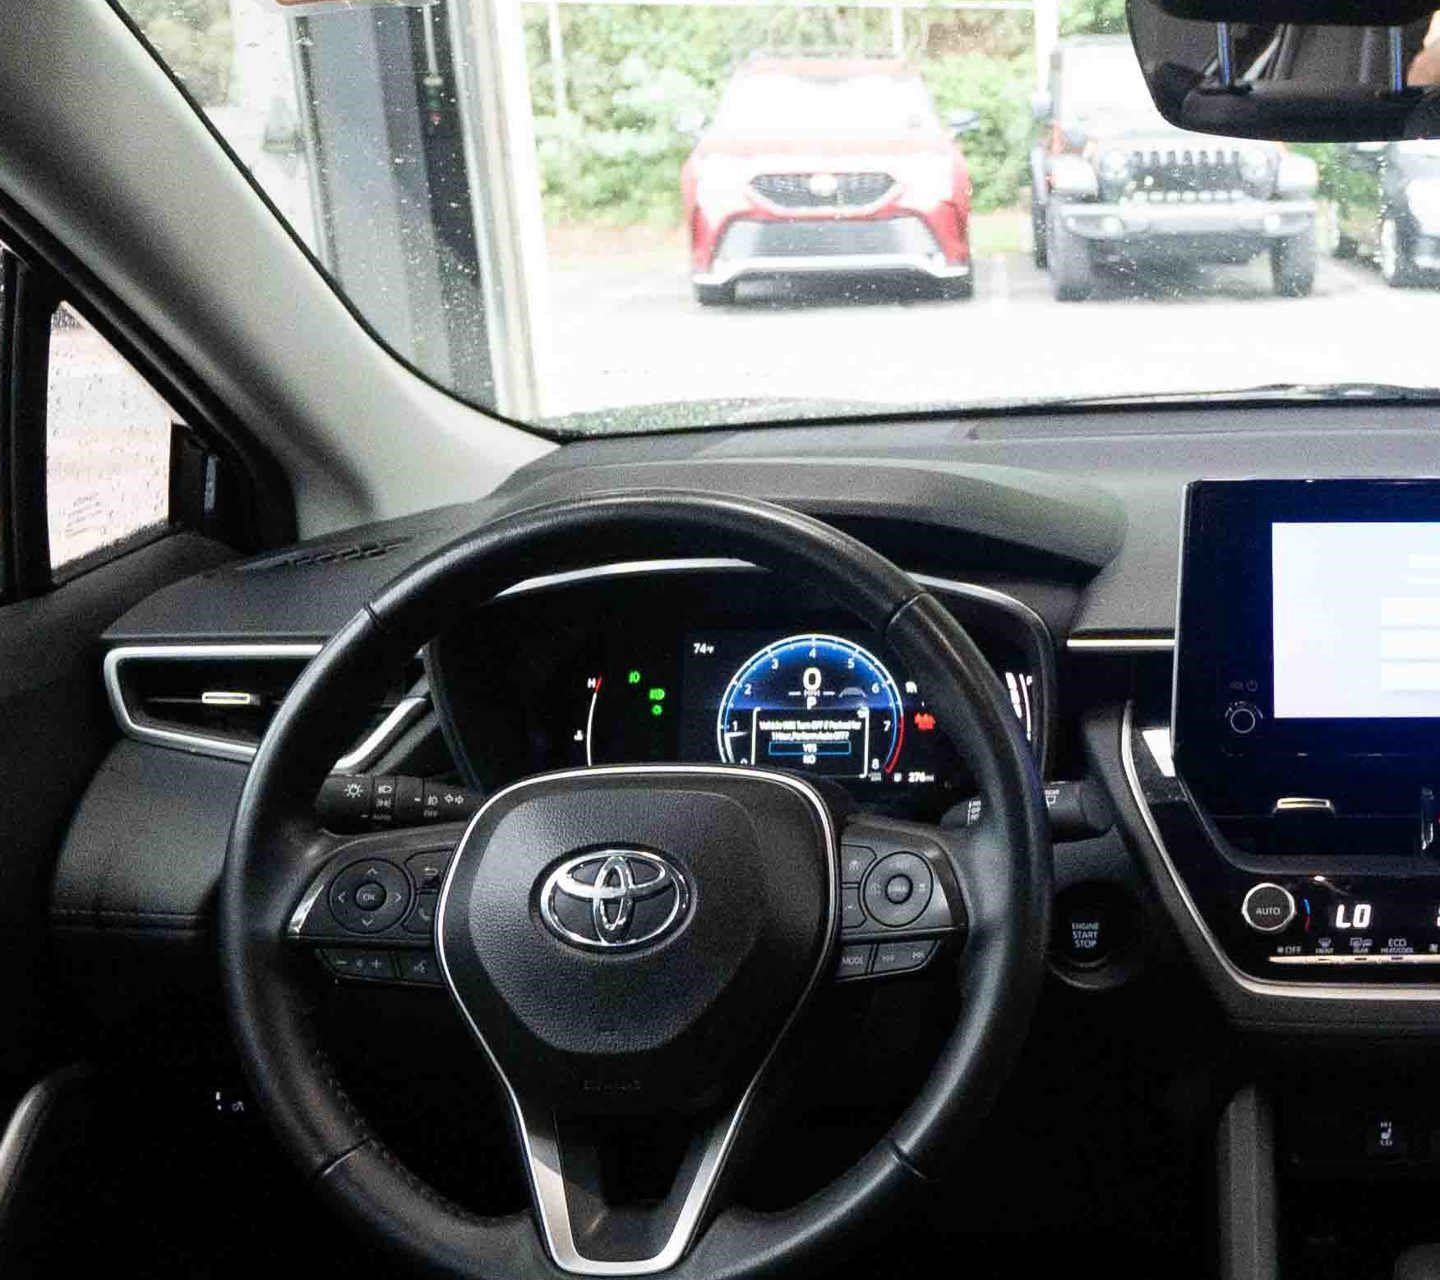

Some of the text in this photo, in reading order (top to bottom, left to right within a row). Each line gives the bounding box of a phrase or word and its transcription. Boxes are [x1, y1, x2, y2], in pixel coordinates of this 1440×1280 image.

[809, 647, 817, 658] 4
[771, 658, 779, 670] 3
[847, 656, 855, 669] 5
[587, 677, 596, 689] H
[803, 667, 821, 692] 0
[744, 683, 752, 695] 2
[871, 682, 880, 694] 6
[806, 696, 817, 710] P
[883, 720, 891, 732] 7
[871, 759, 879, 770] 8
[1256, 906, 1281, 916] AUTO
[1335, 904, 1371, 929] LO
[1072, 922, 1099, 930] ENGINE
[1073, 931, 1098, 939] START
[1075, 940, 1097, 948] STOP
[1388, 938, 1407, 948] ECO
[1285, 945, 1302, 954] OFF
